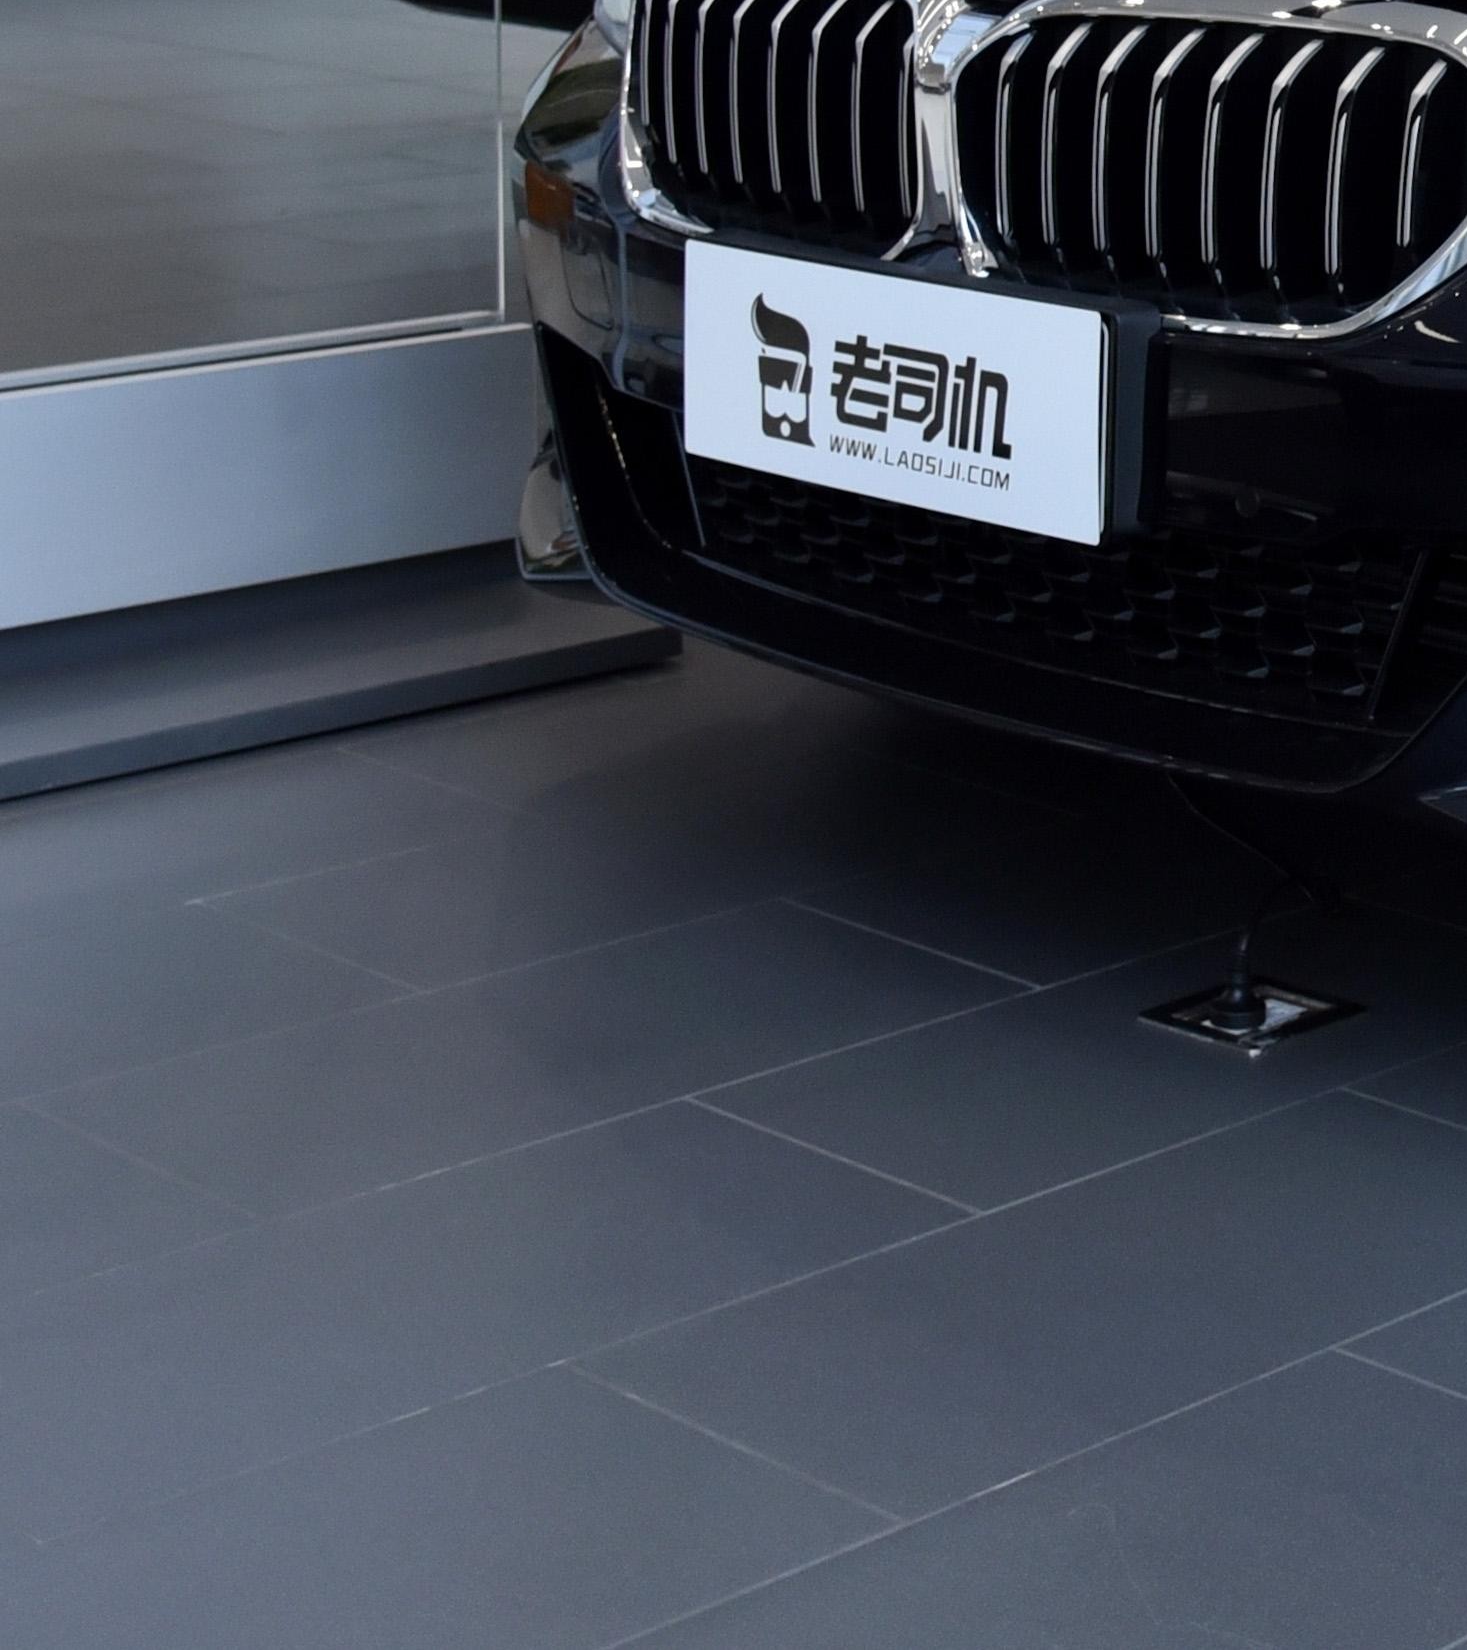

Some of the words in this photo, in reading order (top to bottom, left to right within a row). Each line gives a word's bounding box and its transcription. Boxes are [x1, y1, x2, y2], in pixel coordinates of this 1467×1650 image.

[830, 334, 1013, 460] 老司机
[829, 433, 1011, 492] WWW.LAOSIJI.COM
